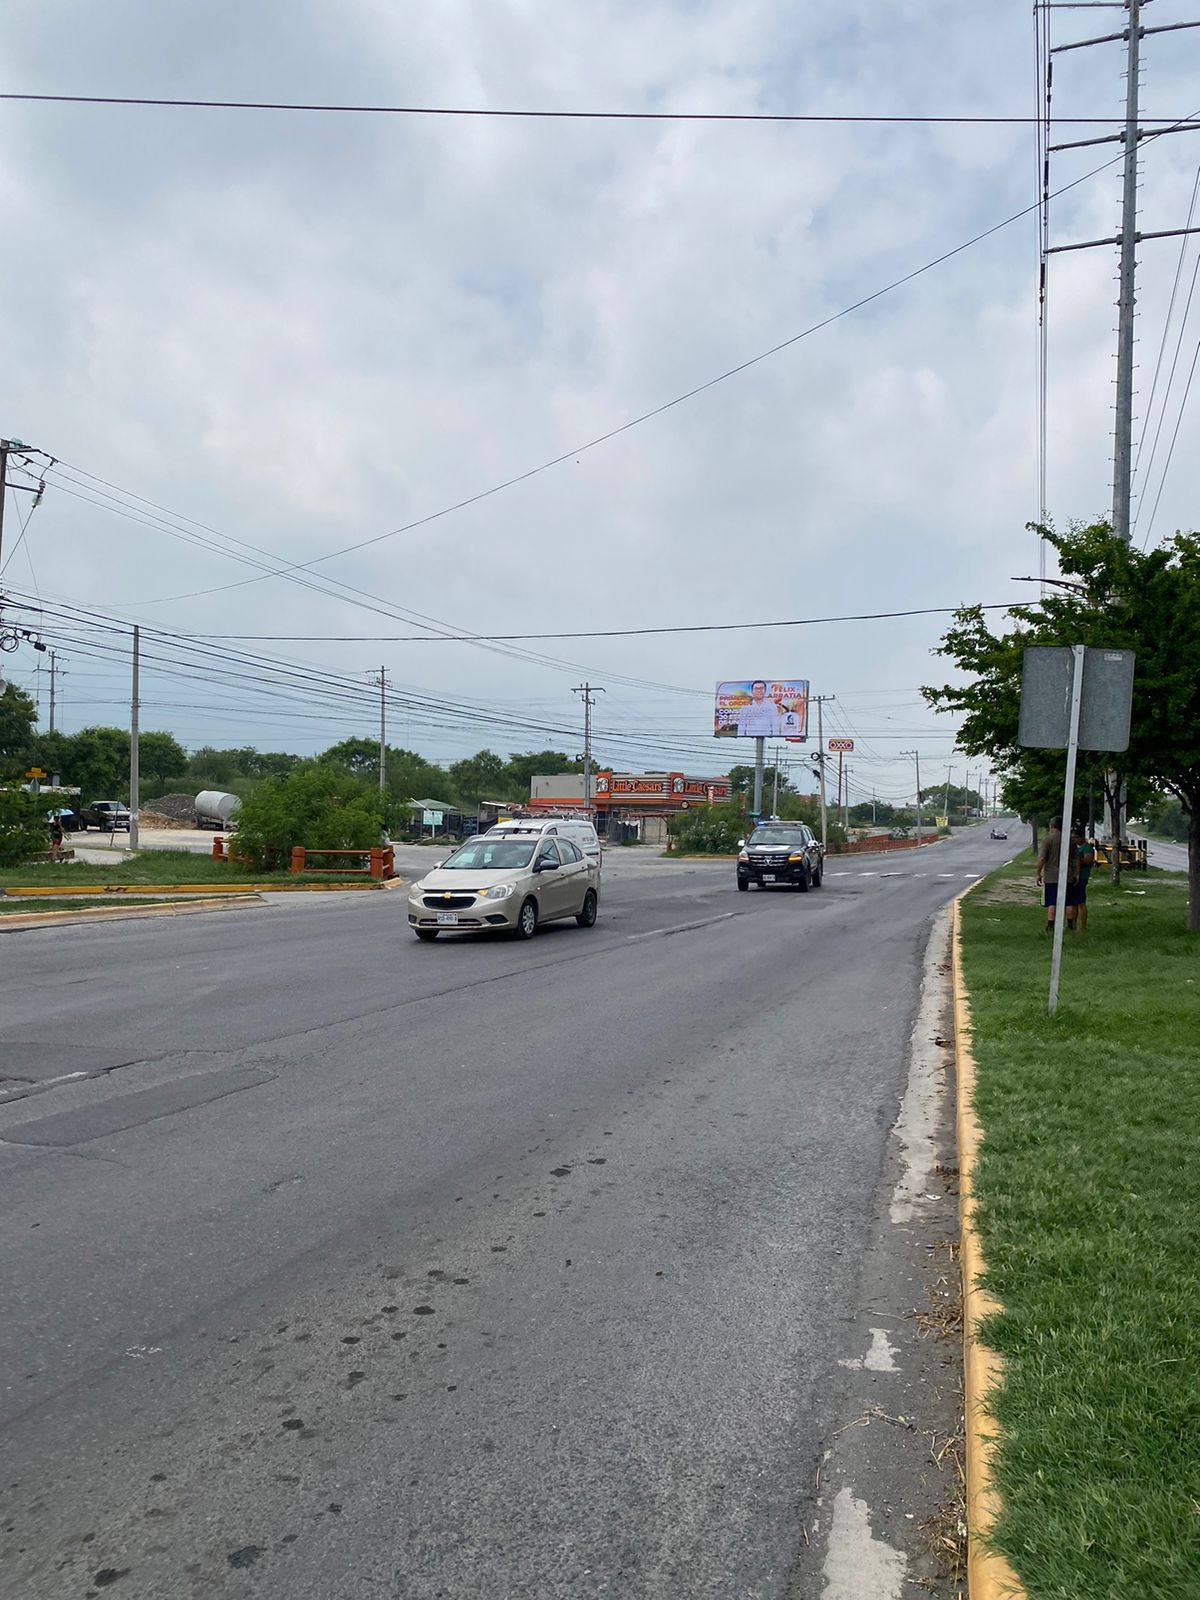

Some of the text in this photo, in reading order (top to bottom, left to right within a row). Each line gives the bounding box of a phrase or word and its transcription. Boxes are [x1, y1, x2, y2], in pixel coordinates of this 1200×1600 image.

[829, 741, 853, 749] OXXO
[612, 780, 662, 792] Little Caesars
